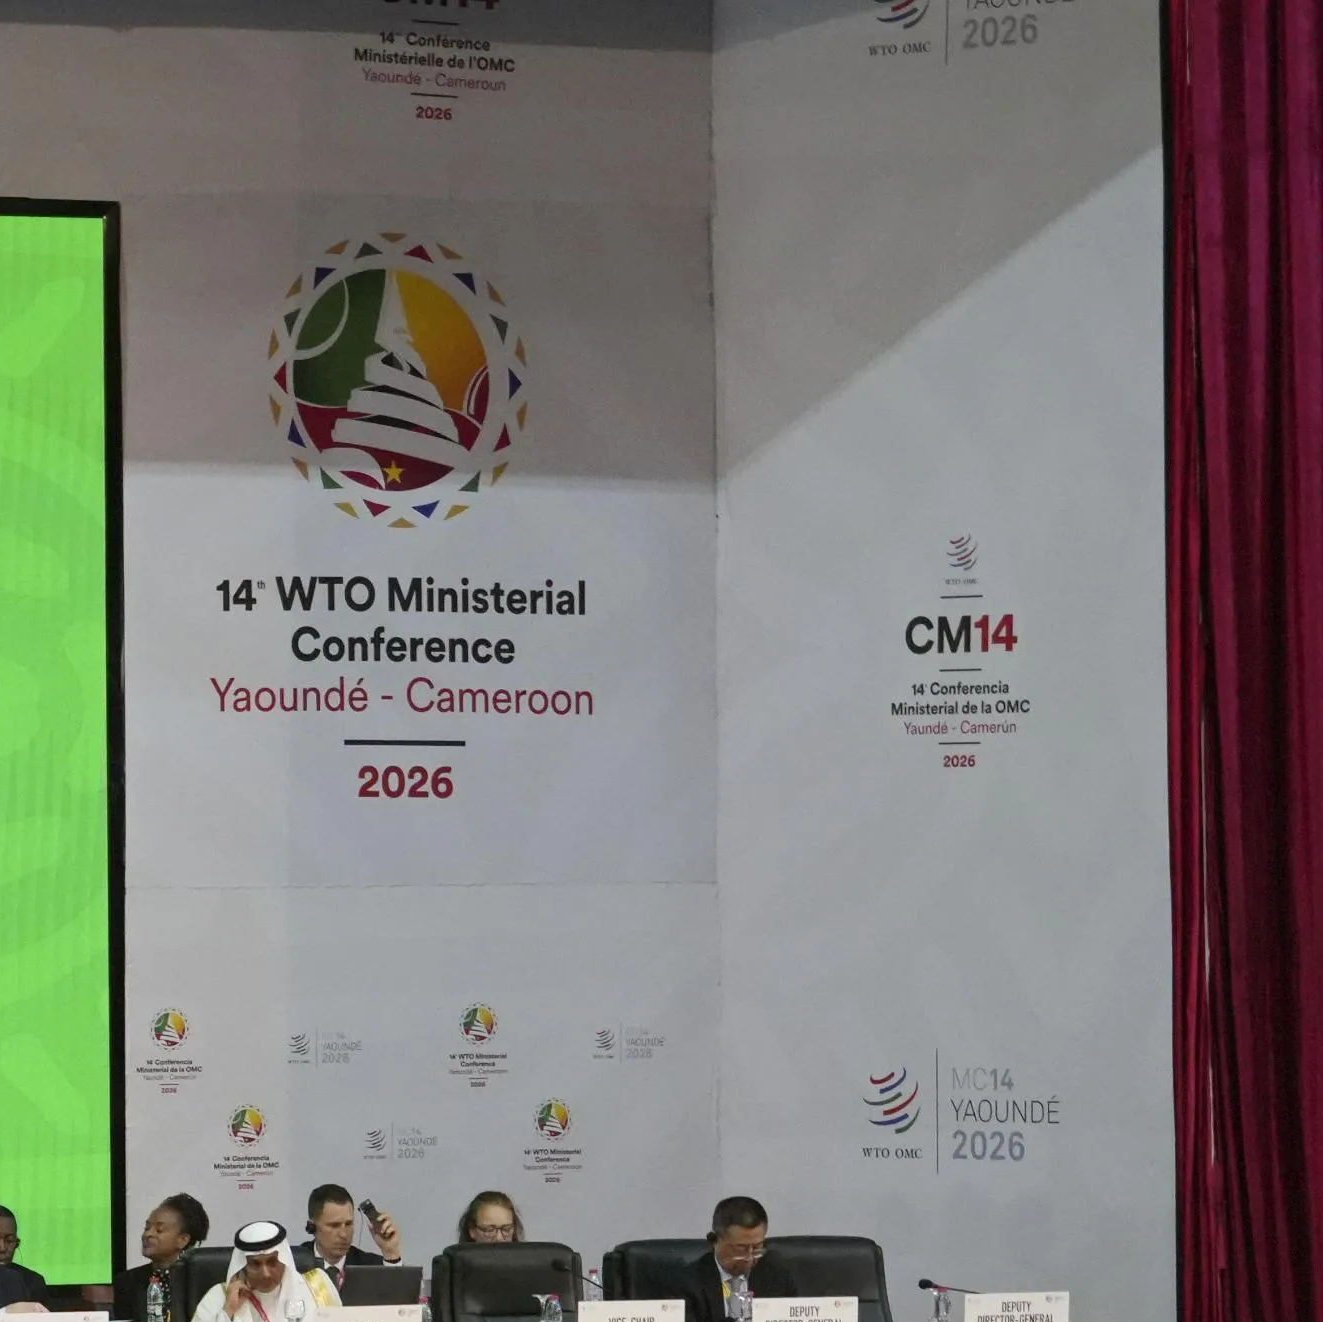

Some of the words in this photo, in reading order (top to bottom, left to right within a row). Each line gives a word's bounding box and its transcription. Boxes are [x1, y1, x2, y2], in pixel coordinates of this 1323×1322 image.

[963, 14, 1038, 49] 2026
[903, 42, 930, 54] OMC
[446, 55, 465, 69] de
[362, 68, 421, 86] Yaoundé
[435, 73, 506, 91] Cameroun
[416, 106, 452, 120] 2026
[276, 576, 375, 612] WTO
[388, 576, 585, 615] Ministerial
[906, 614, 1017, 654] CM14
[292, 626, 515, 664] Conference
[211, 676, 368, 712] Yaoundé
[407, 677, 592, 715] Cameroon
[930, 681, 1009, 695] Conferencia
[892, 701, 958, 715] Ministerial
[962, 701, 977, 714] de
[982, 701, 991, 714] la
[995, 700, 1030, 713] OMC
[904, 721, 948, 735] Yaundé
[960, 720, 1016, 734] Camerún
[944, 755, 975, 767] 2026
[359, 766, 453, 798] 2026
[952, 1067, 1014, 1091] MC14
[951, 1096, 1059, 1124] YAOUNDÉ
[863, 1148, 889, 1158] WTO
[895, 1149, 922, 1158] OMC
[953, 1130, 1024, 1161] 2026
[790, 1306, 819, 1320] DEPUTY
[1002, 1301, 1031, 1312] DEPUTY
